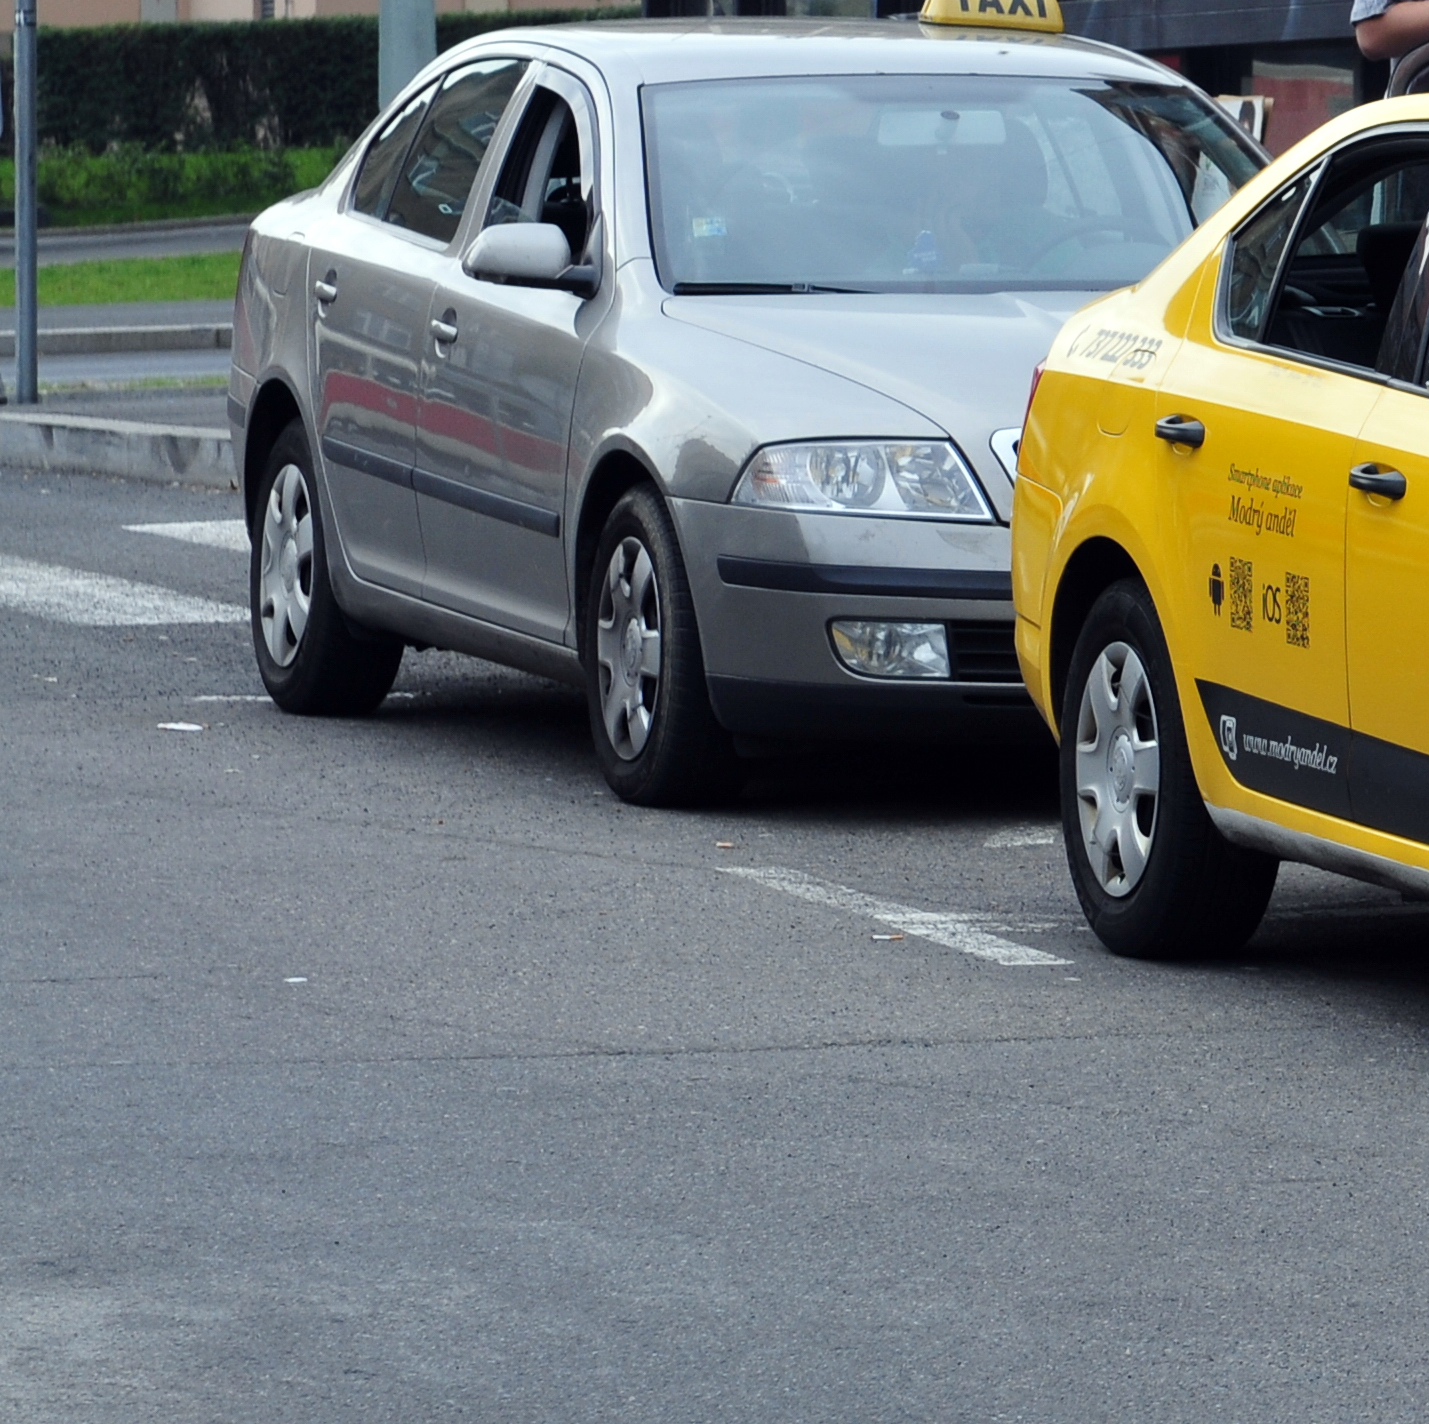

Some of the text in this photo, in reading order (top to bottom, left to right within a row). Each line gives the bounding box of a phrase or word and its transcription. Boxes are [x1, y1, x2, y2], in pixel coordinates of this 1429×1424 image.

[1227, 462, 1272, 492] Smartphone
[1227, 494, 1297, 537] Modrý anděl
[1262, 583, 1282, 625] iOS
[1243, 734, 1338, 775] www.modryandel.cz
